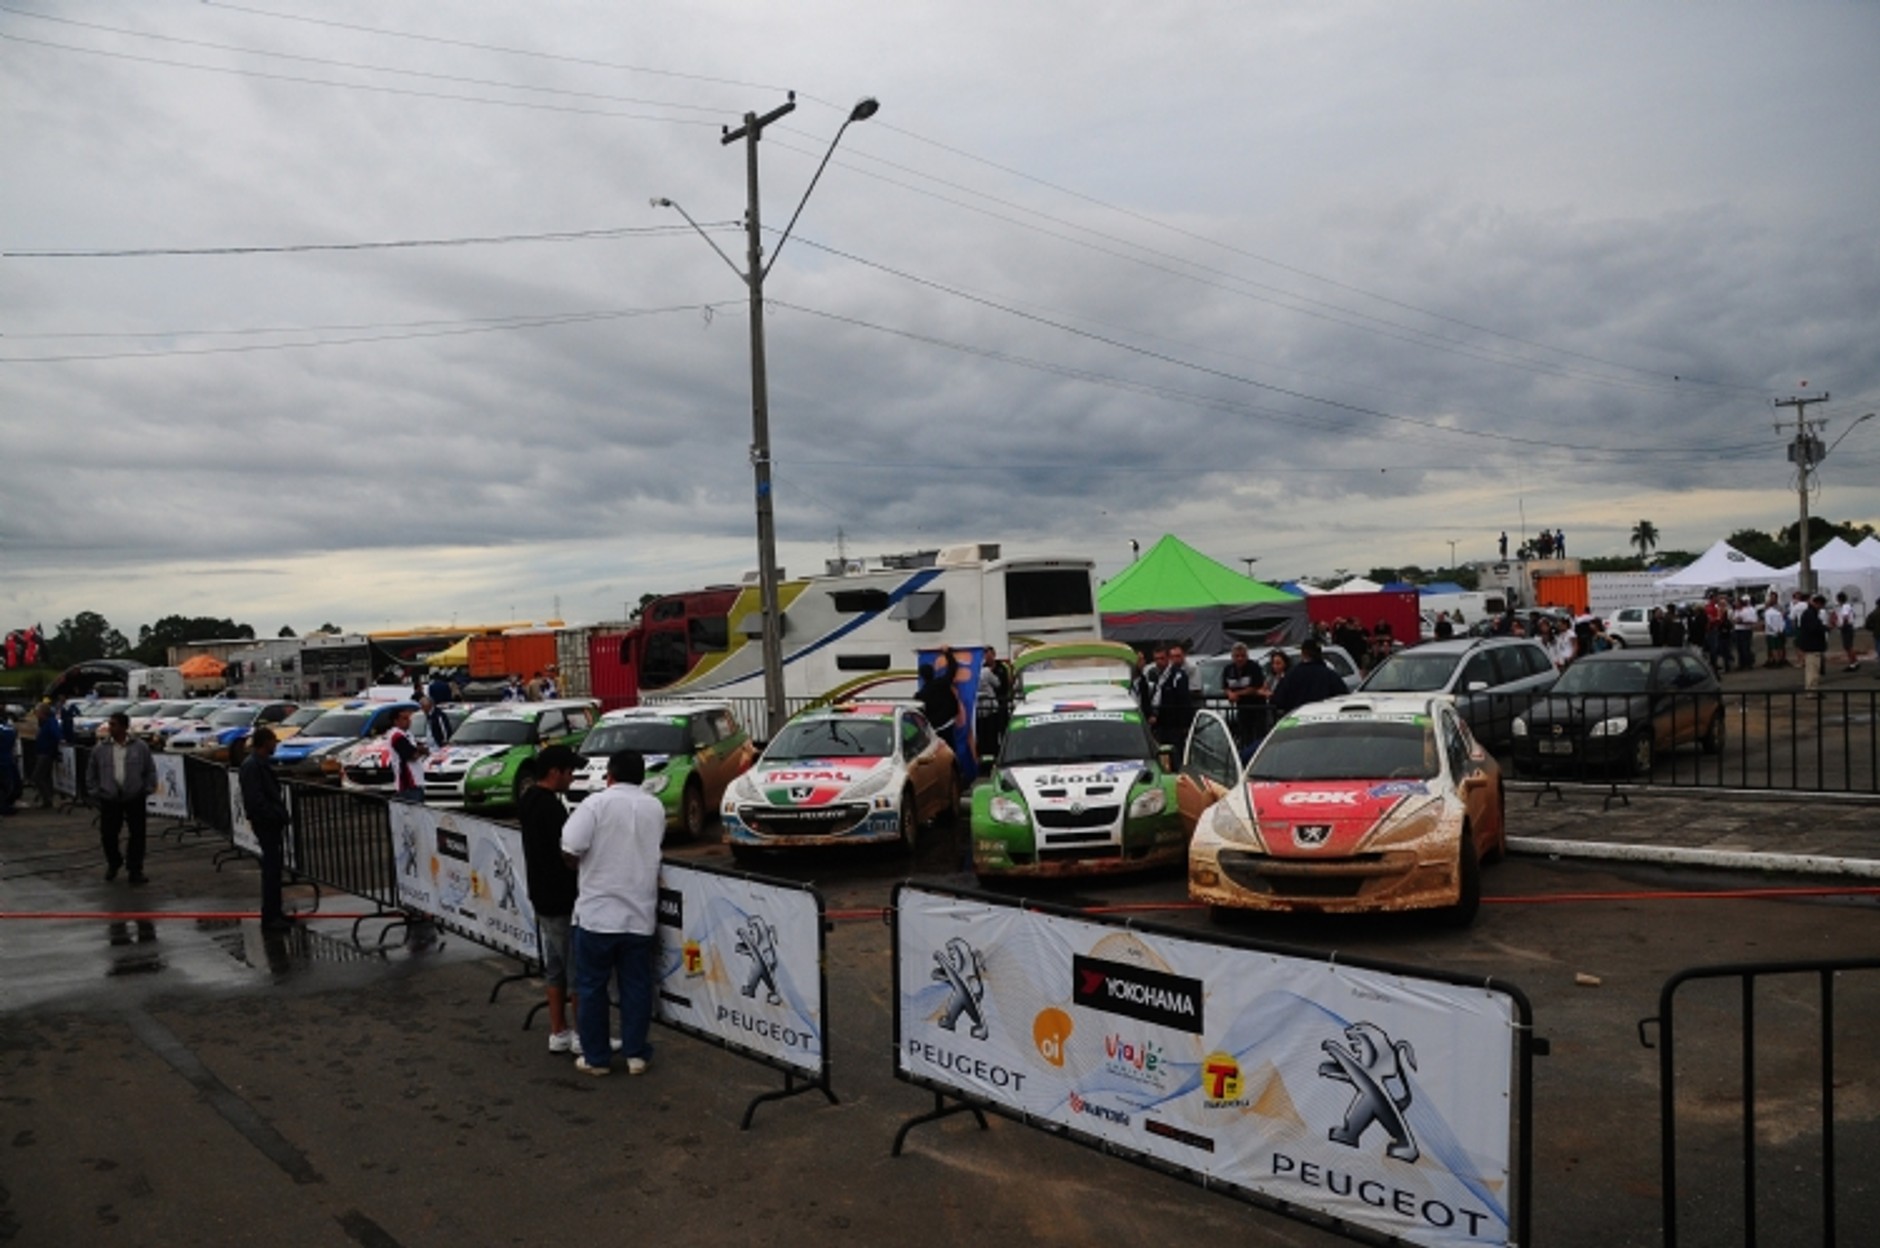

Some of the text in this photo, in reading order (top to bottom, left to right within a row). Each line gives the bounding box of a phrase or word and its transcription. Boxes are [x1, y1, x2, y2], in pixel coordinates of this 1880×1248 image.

[768, 772, 851, 783] TOTAL
[1282, 791, 1357, 804] GDK
[1106, 977, 1195, 1016] YOKOHAMA
[716, 1004, 813, 1049] PEUGEOT
[909, 1039, 1026, 1093] PEUGEOT
[1273, 1152, 1488, 1237] PEUGEOT
